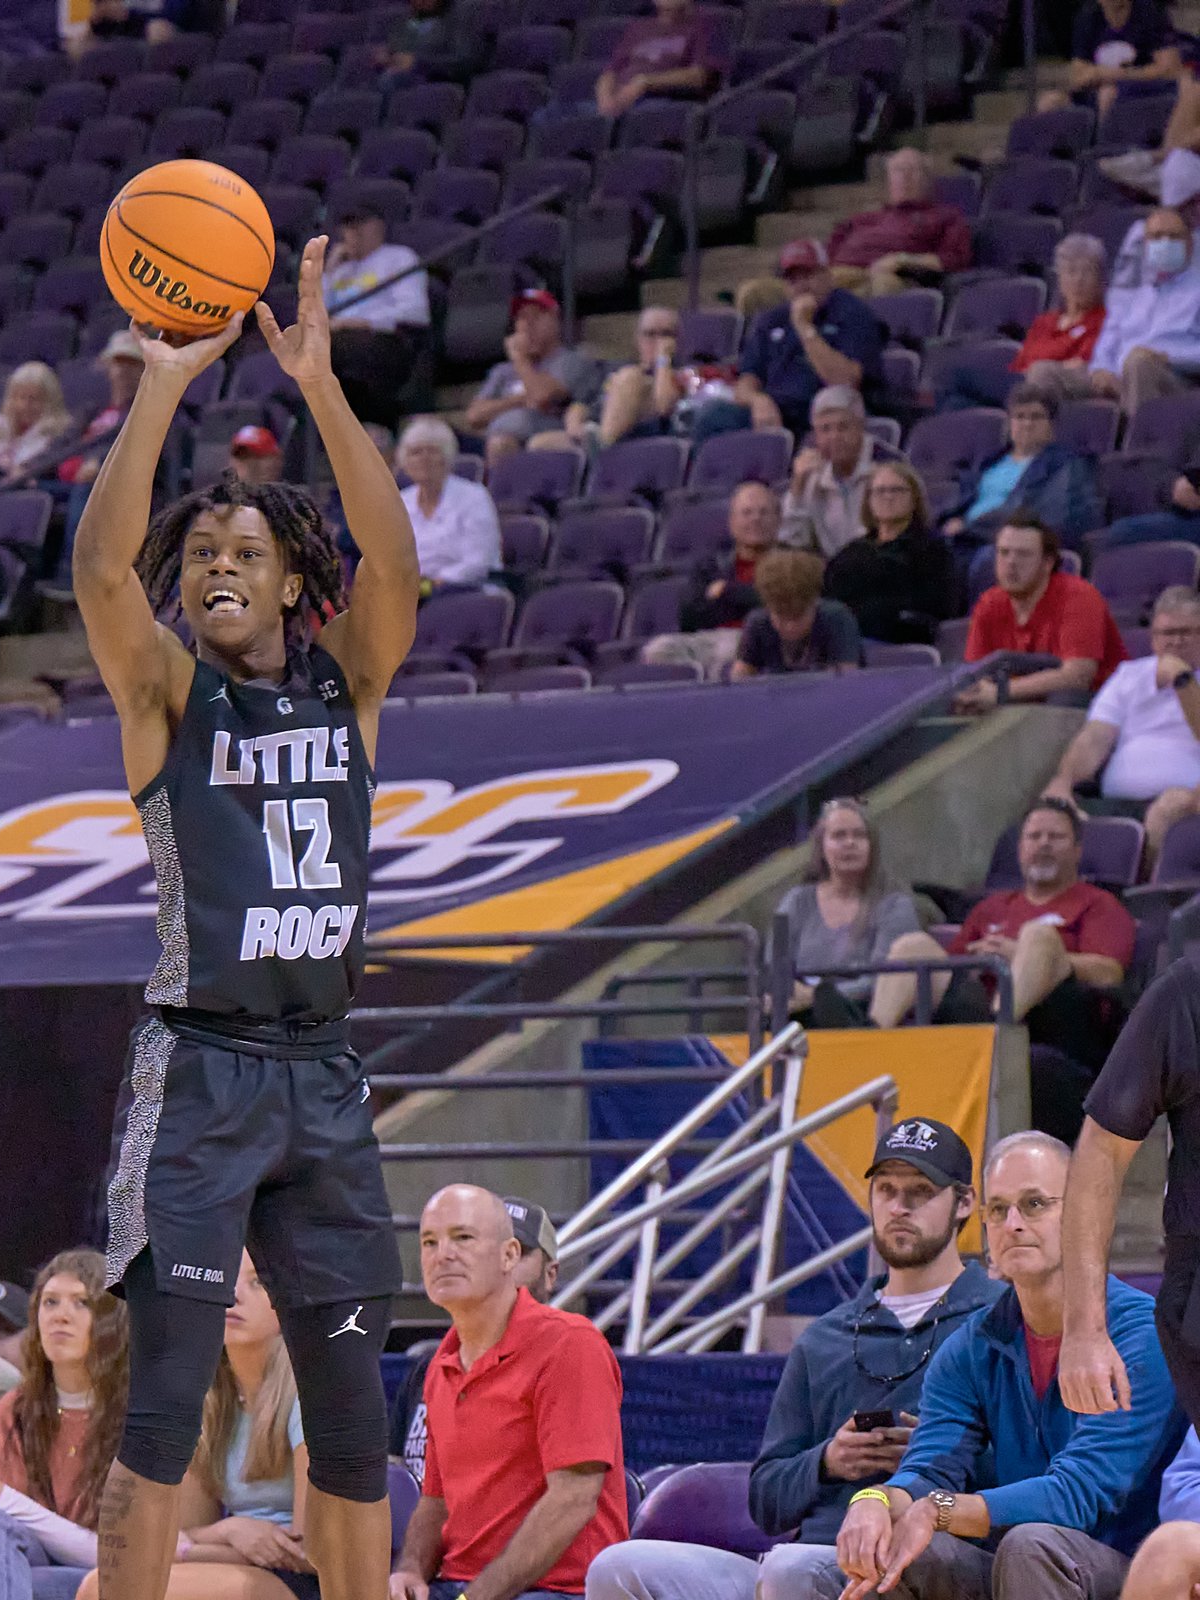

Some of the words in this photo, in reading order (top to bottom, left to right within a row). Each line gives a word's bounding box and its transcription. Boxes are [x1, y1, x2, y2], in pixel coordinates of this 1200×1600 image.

[128, 249, 231, 320] Wilson
[209, 726, 349, 786] LITTLE
[262, 797, 343, 890] 12
[171, 1263, 204, 1280] LITTLE
